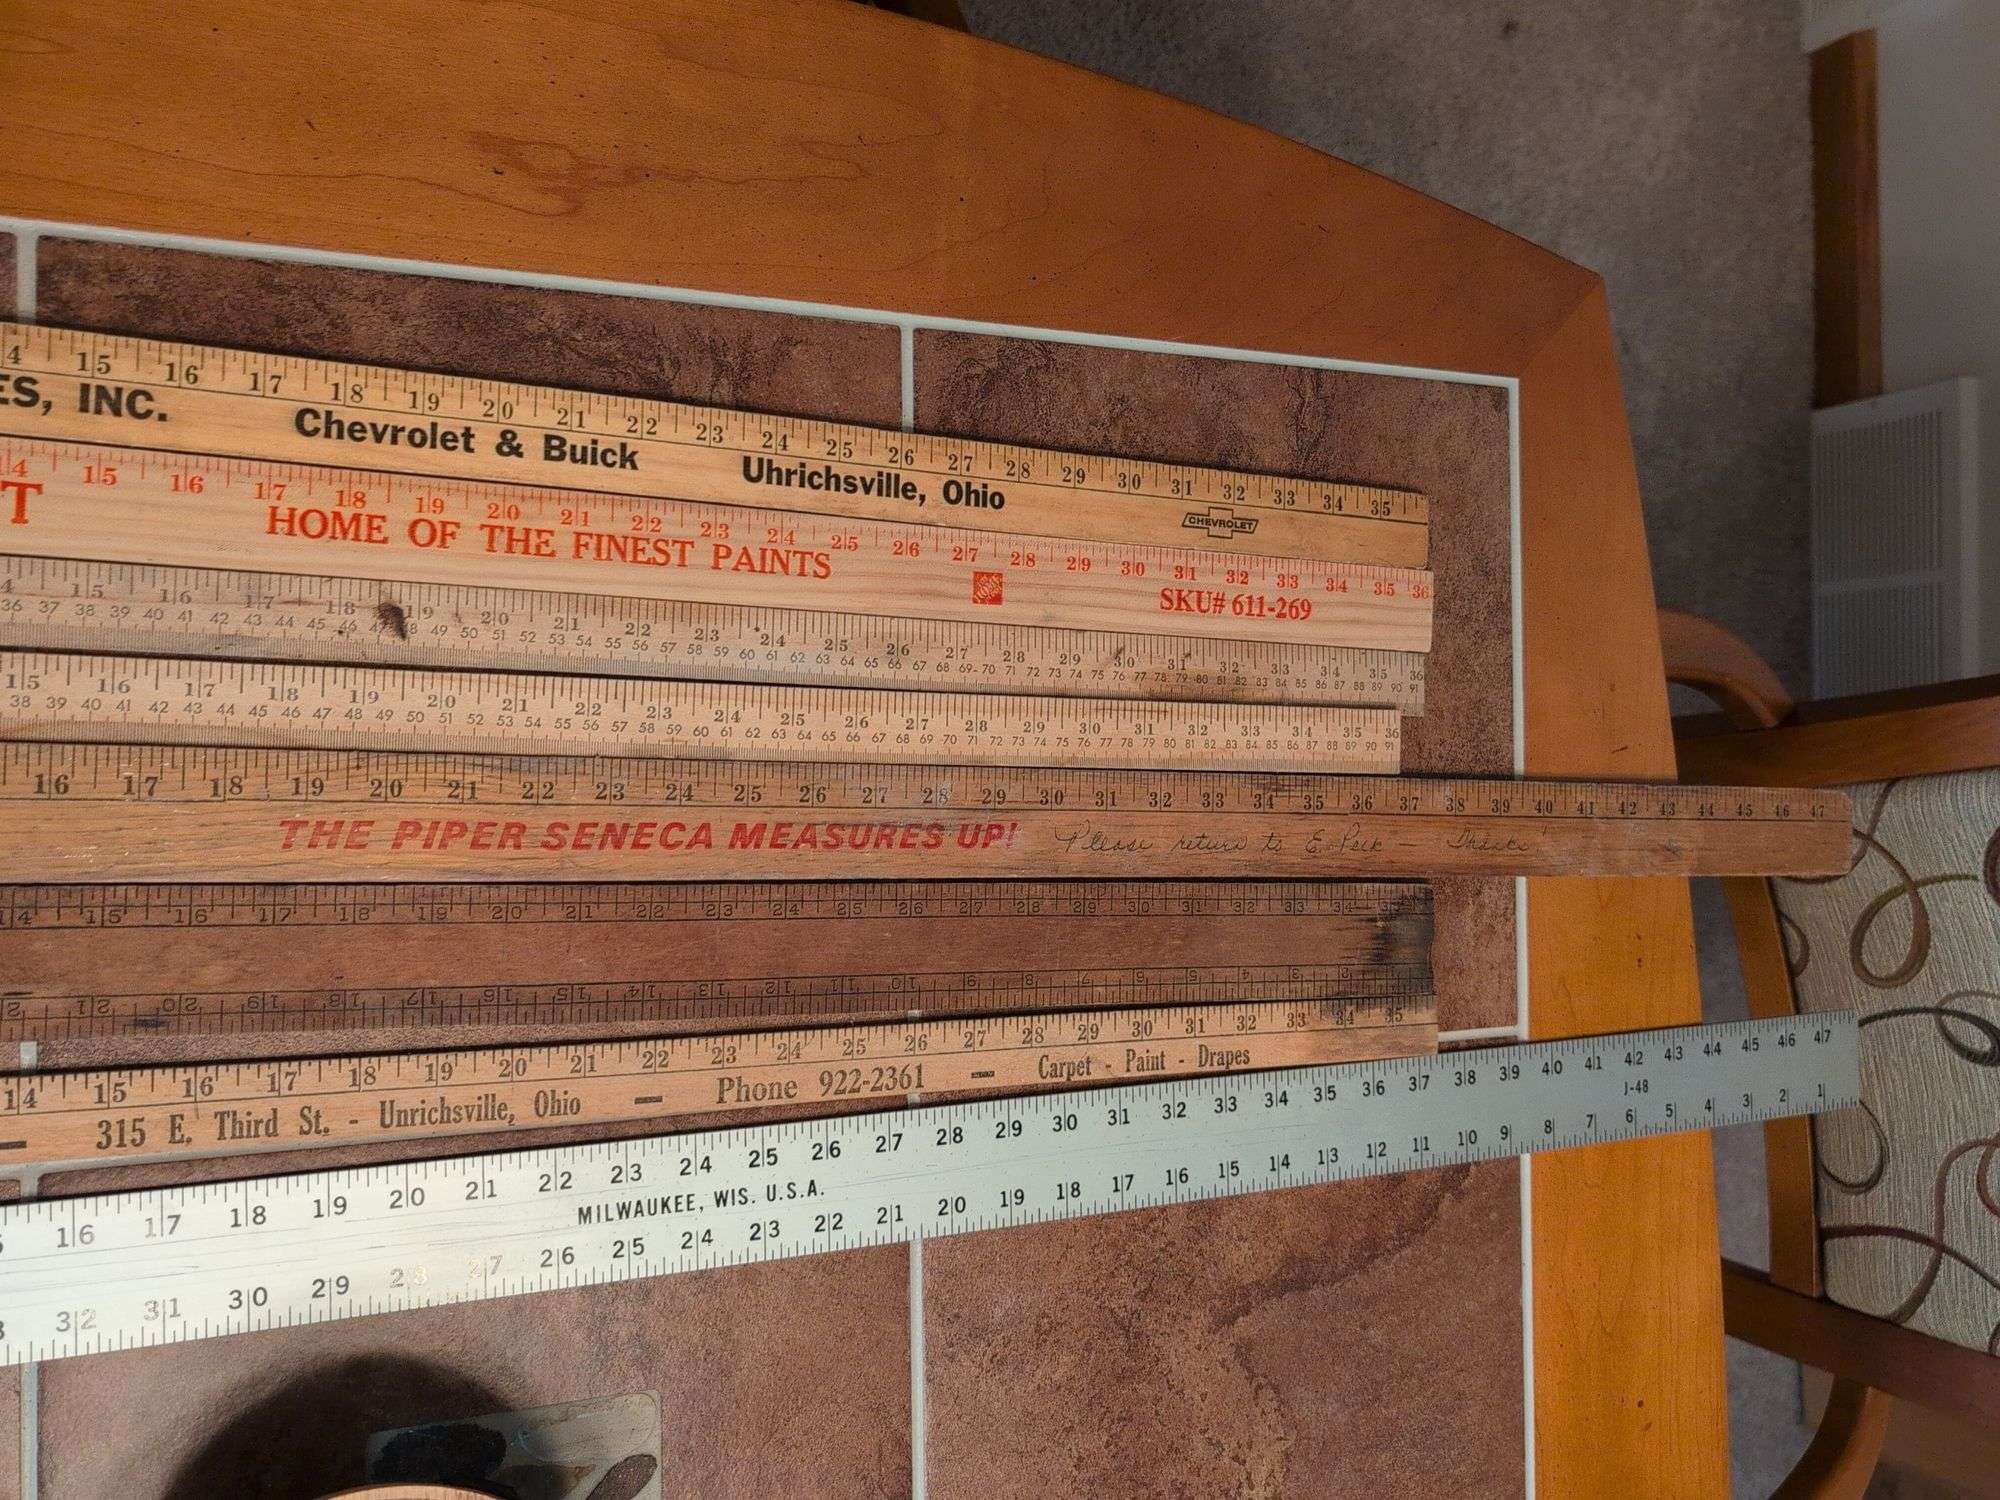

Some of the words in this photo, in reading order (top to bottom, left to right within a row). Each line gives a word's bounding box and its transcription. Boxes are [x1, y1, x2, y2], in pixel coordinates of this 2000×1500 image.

[77, 353, 111, 374] 15
[250, 372, 282, 395] 17
[331, 383, 364, 403] 18
[483, 400, 513, 419] 20
[627, 415, 657, 436] 22
[696, 424, 723, 444] 23
[827, 439, 853, 459] 25
[888, 447, 914, 466] 26
[948, 454, 973, 472] 27
[1062, 466, 1085, 484] 29
[1118, 472, 1141, 489] 30
[1224, 485, 1244, 500] 32
[1274, 490, 1295, 506] 33
[1371, 500, 1391, 516] 35
[79, 384, 167, 421] INC.
[295, 409, 475, 453] Chevrolet
[496, 429, 523, 458] &
[544, 434, 639, 470] Buick
[743, 456, 927, 506] Uhrichsville,
[943, 480, 1005, 510] Ohio
[84, 466, 117, 485] 15
[255, 482, 286, 500] 17
[415, 497, 445, 514] 19
[487, 503, 520, 520] 20
[632, 515, 662, 533] 22
[767, 528, 796, 545] 24
[893, 540, 920, 557] 26
[953, 546, 978, 562] 27
[1067, 557, 1091, 571] 29
[1121, 561, 1145, 576] 30
[1227, 570, 1248, 584] 32
[1326, 578, 1347, 592] 34
[1412, 585, 1428, 599] 36
[1188, 516, 1253, 530] CHEVROLET
[267, 506, 389, 544] HOME
[407, 519, 462, 548] OF
[480, 524, 556, 558] THE
[571, 531, 694, 567] FINEST
[712, 544, 832, 579] PAINTS
[1160, 588, 1226, 613] SKU#
[1232, 594, 1312, 620] 611-269
[554, 617, 579, 631] 21
[761, 633, 785, 647] 24
[887, 642, 909, 656] 26
[1004, 651, 1025, 663] 28
[1410, 670, 1424, 681] 36
[10, 695, 31, 708] 38
[81, 698, 101, 711] 40
[407, 712, 424, 723] 50
[693, 725, 708, 737] 60
[99, 679, 130, 693] 16
[268, 686, 299, 701] 18
[576, 702, 601, 716] 22
[781, 713, 804, 726] 25
[965, 720, 988, 732] 28
[1292, 726, 1312, 737] 34
[1385, 728, 1399, 738] 36
[33, 774, 69, 794] 16
[210, 777, 243, 796] 18
[371, 779, 401, 797] 20
[522, 781, 554, 799] 22
[666, 783, 693, 800] 24
[800, 786, 826, 803] 26
[982, 788, 1006, 805] 29
[1040, 789, 1064, 806] 30
[1150, 792, 1172, 808] 32
[1304, 794, 1324, 810] 35
[1400, 796, 1419, 811] 37
[1491, 799, 1510, 813] 39
[1618, 802, 1637, 815] 42
[1810, 804, 1824, 817] 47
[280, 820, 375, 849] THE
[391, 820, 527, 850] PIPER
[539, 821, 713, 850] SENECA
[728, 822, 946, 849] MEASURES
[957, 822, 1018, 849] UP!
[1055, 819, 1152, 851] Please
[4, 1088, 37, 1110] 14
[182, 1076, 213, 1098] 16
[349, 1066, 376, 1087] 18
[425, 1061, 453, 1082] 19
[499, 1059, 526, 1078] 20
[642, 1051, 669, 1069] 22
[778, 1043, 800, 1060] 24
[905, 1034, 927, 1052] 26
[1022, 1027, 1044, 1044] 28
[1132, 1020, 1152, 1037] 30
[1237, 1015, 1257, 1031] 32
[1625, 1080, 1648, 1094] J-48
[97, 1116, 146, 1149] 315
[169, 1114, 192, 1144] E.
[215, 1108, 278, 1141] Third
[299, 1105, 330, 1136] St.
[535, 1090, 581, 1117] Ohio
[716, 1076, 798, 1104] Phone
[820, 1063, 924, 1096] 922-2361
[1039, 1055, 1091, 1080] Carpet
[1126, 1049, 1165, 1073] Paint
[1198, 1044, 1249, 1069] Drapes
[57, 1225, 95, 1248] 16
[230, 1206, 266, 1227] 18
[313, 1197, 347, 1217] 19
[389, 1188, 425, 1209] 20
[539, 1172, 572, 1192] 22
[680, 1156, 712, 1176] 24
[812, 1141, 841, 1160] 26
[936, 1127, 963, 1146] 28
[1052, 1114, 1078, 1133] 30
[1162, 1102, 1187, 1119] 32
[1264, 1090, 1288, 1107] 34
[1362, 1080, 1385, 1097] 36
[1454, 1070, 1476, 1086] 38
[1541, 1059, 1562, 1075] 40
[1625, 1051, 1643, 1066] 42
[1704, 1041, 1721, 1056] 44
[1814, 1029, 1831, 1044] 47
[229, 1287, 268, 1310] 30
[311, 1276, 349, 1298] 29
[612, 1238, 644, 1259] 25
[750, 1221, 780, 1241] 23
[877, 1205, 903, 1224] 21
[938, 1197, 966, 1216] 20
[1056, 1182, 1081, 1200] 18
[1166, 1168, 1189, 1186] 16
[1269, 1154, 1290, 1172] 14
[1367, 1141, 1387, 1159] 12
[1458, 1129, 1477, 1146] 10
[1544, 1119, 1553, 1135] 8
[1625, 1109, 1633, 1125] 6
[1704, 1098, 1712, 1114] 4
[1817, 1084, 1823, 1098] 1
[578, 1193, 705, 1225] MILWAUKEE,
[714, 1189, 755, 1208] WIS.
[767, 1180, 824, 1200] U.S.A.
